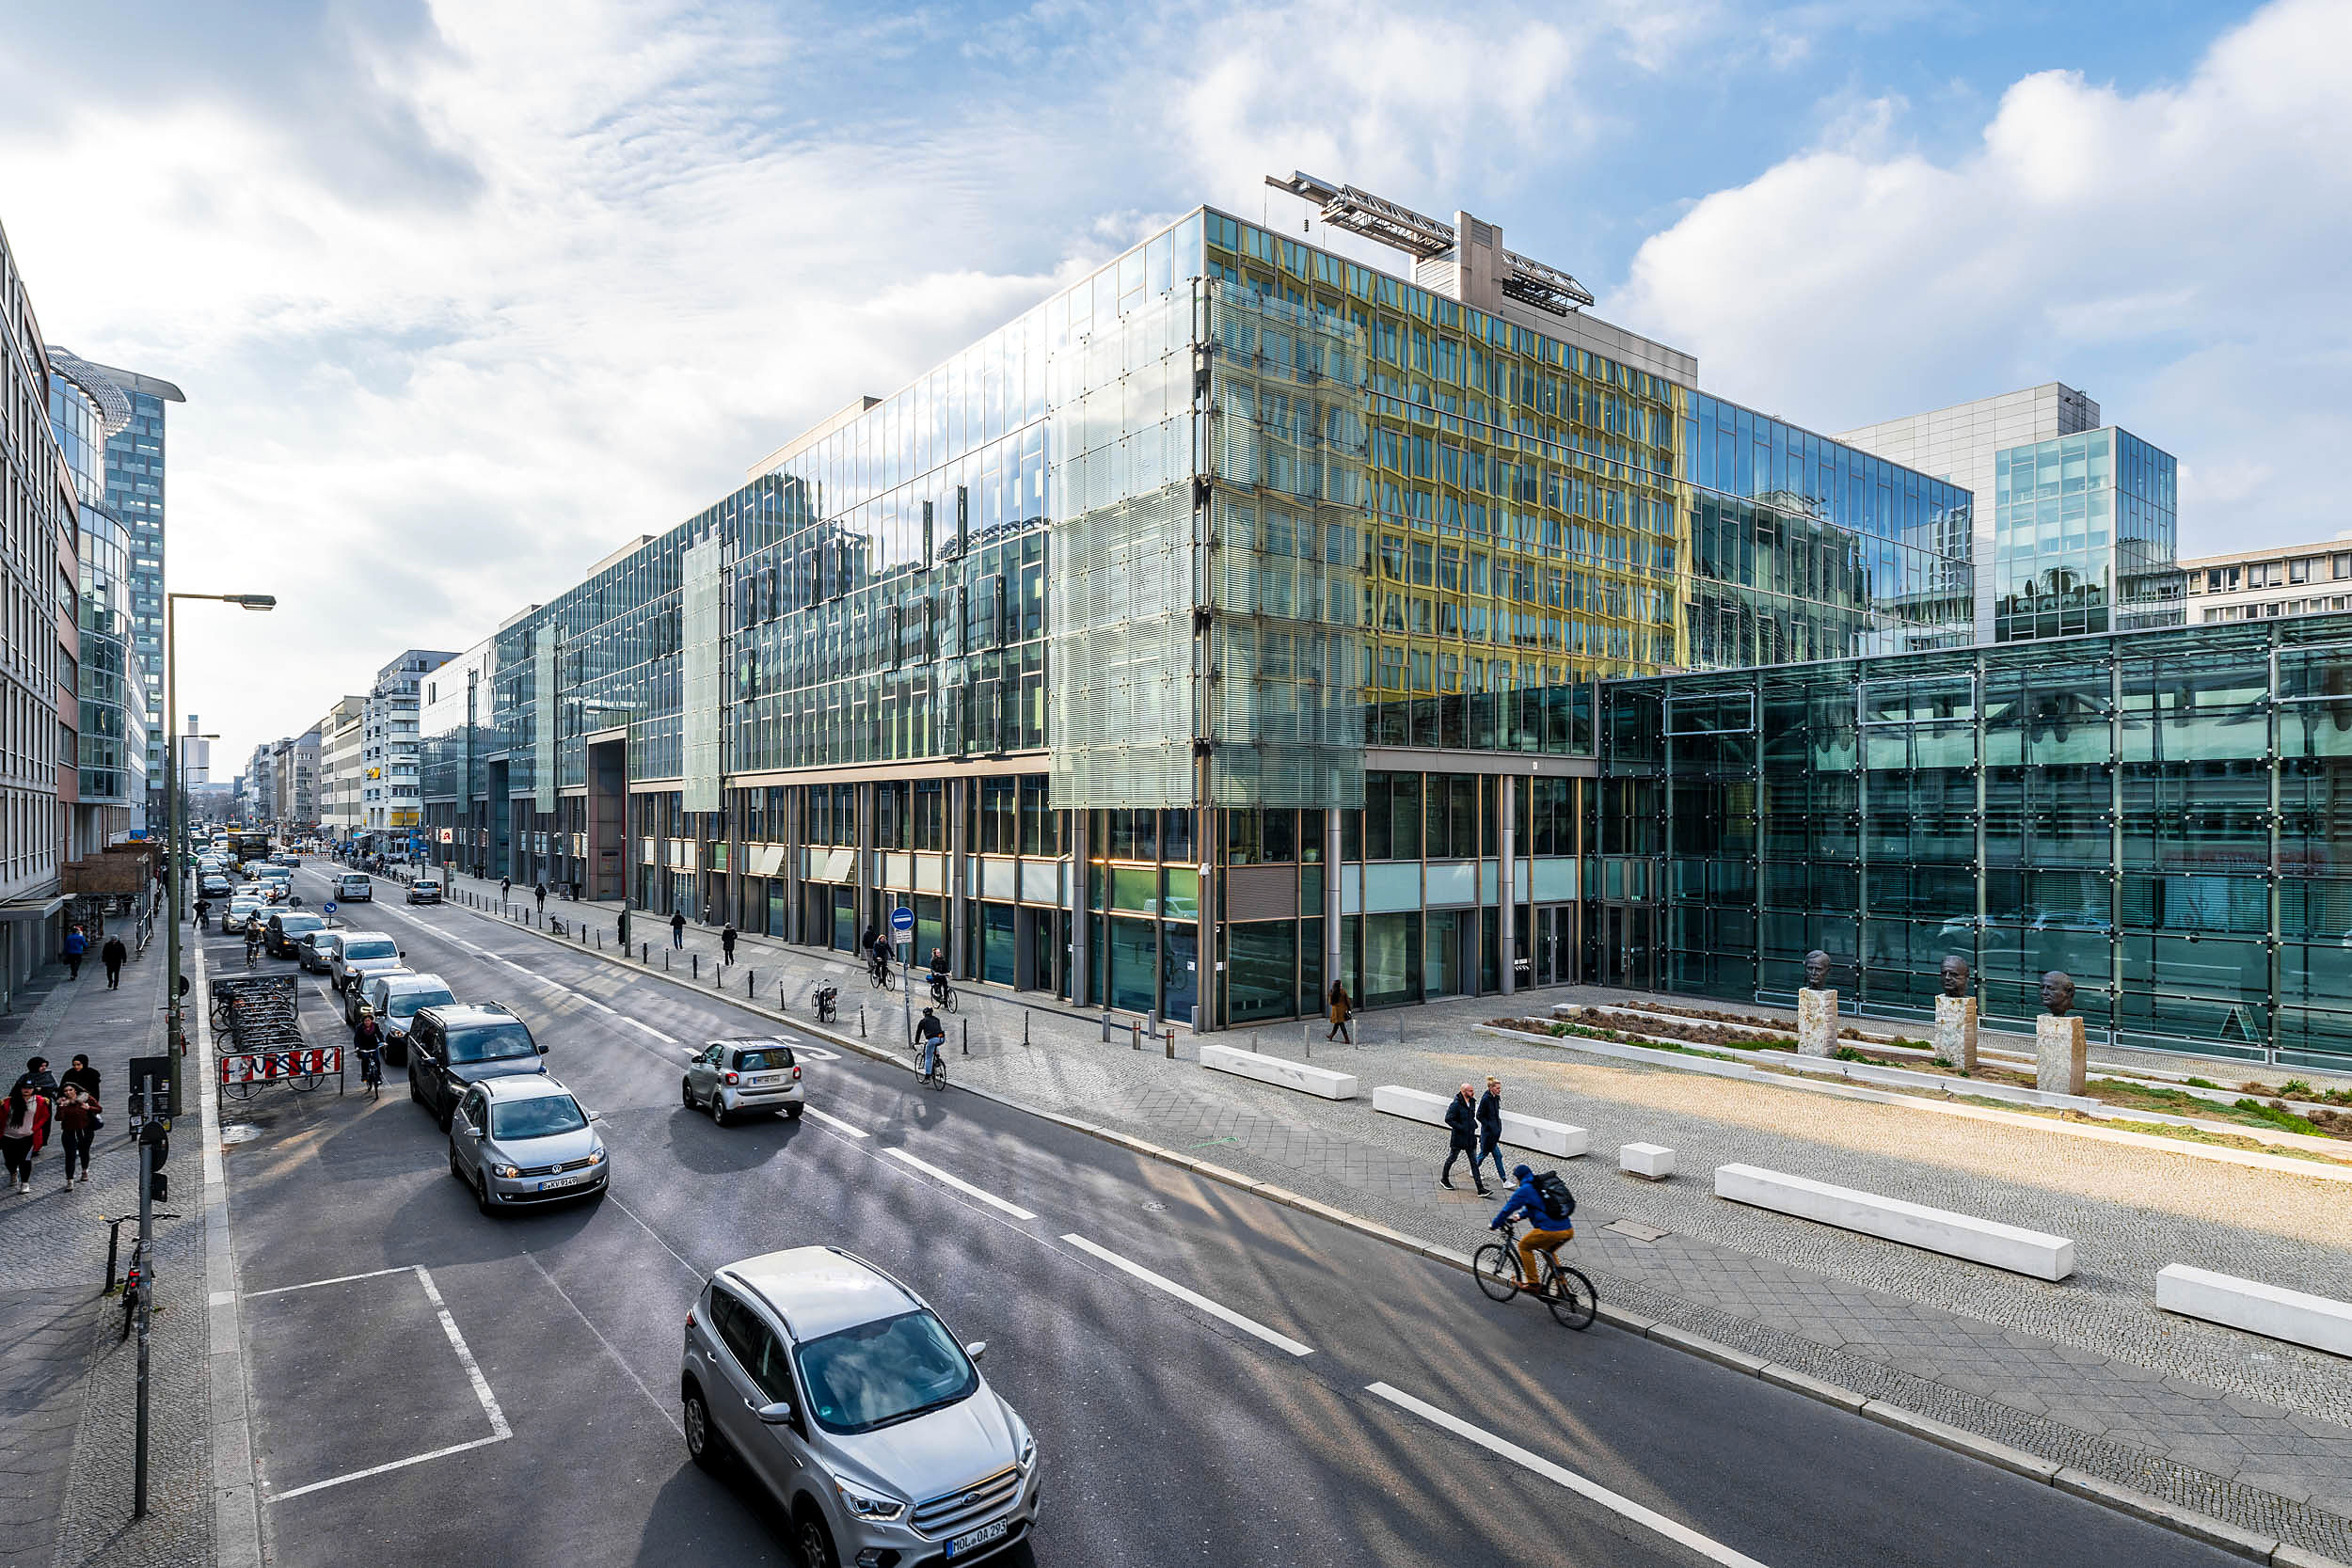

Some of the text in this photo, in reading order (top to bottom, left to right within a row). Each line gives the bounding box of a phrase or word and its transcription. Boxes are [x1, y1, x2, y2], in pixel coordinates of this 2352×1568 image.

[953, 1520, 1006, 1552] MOL OA 293
